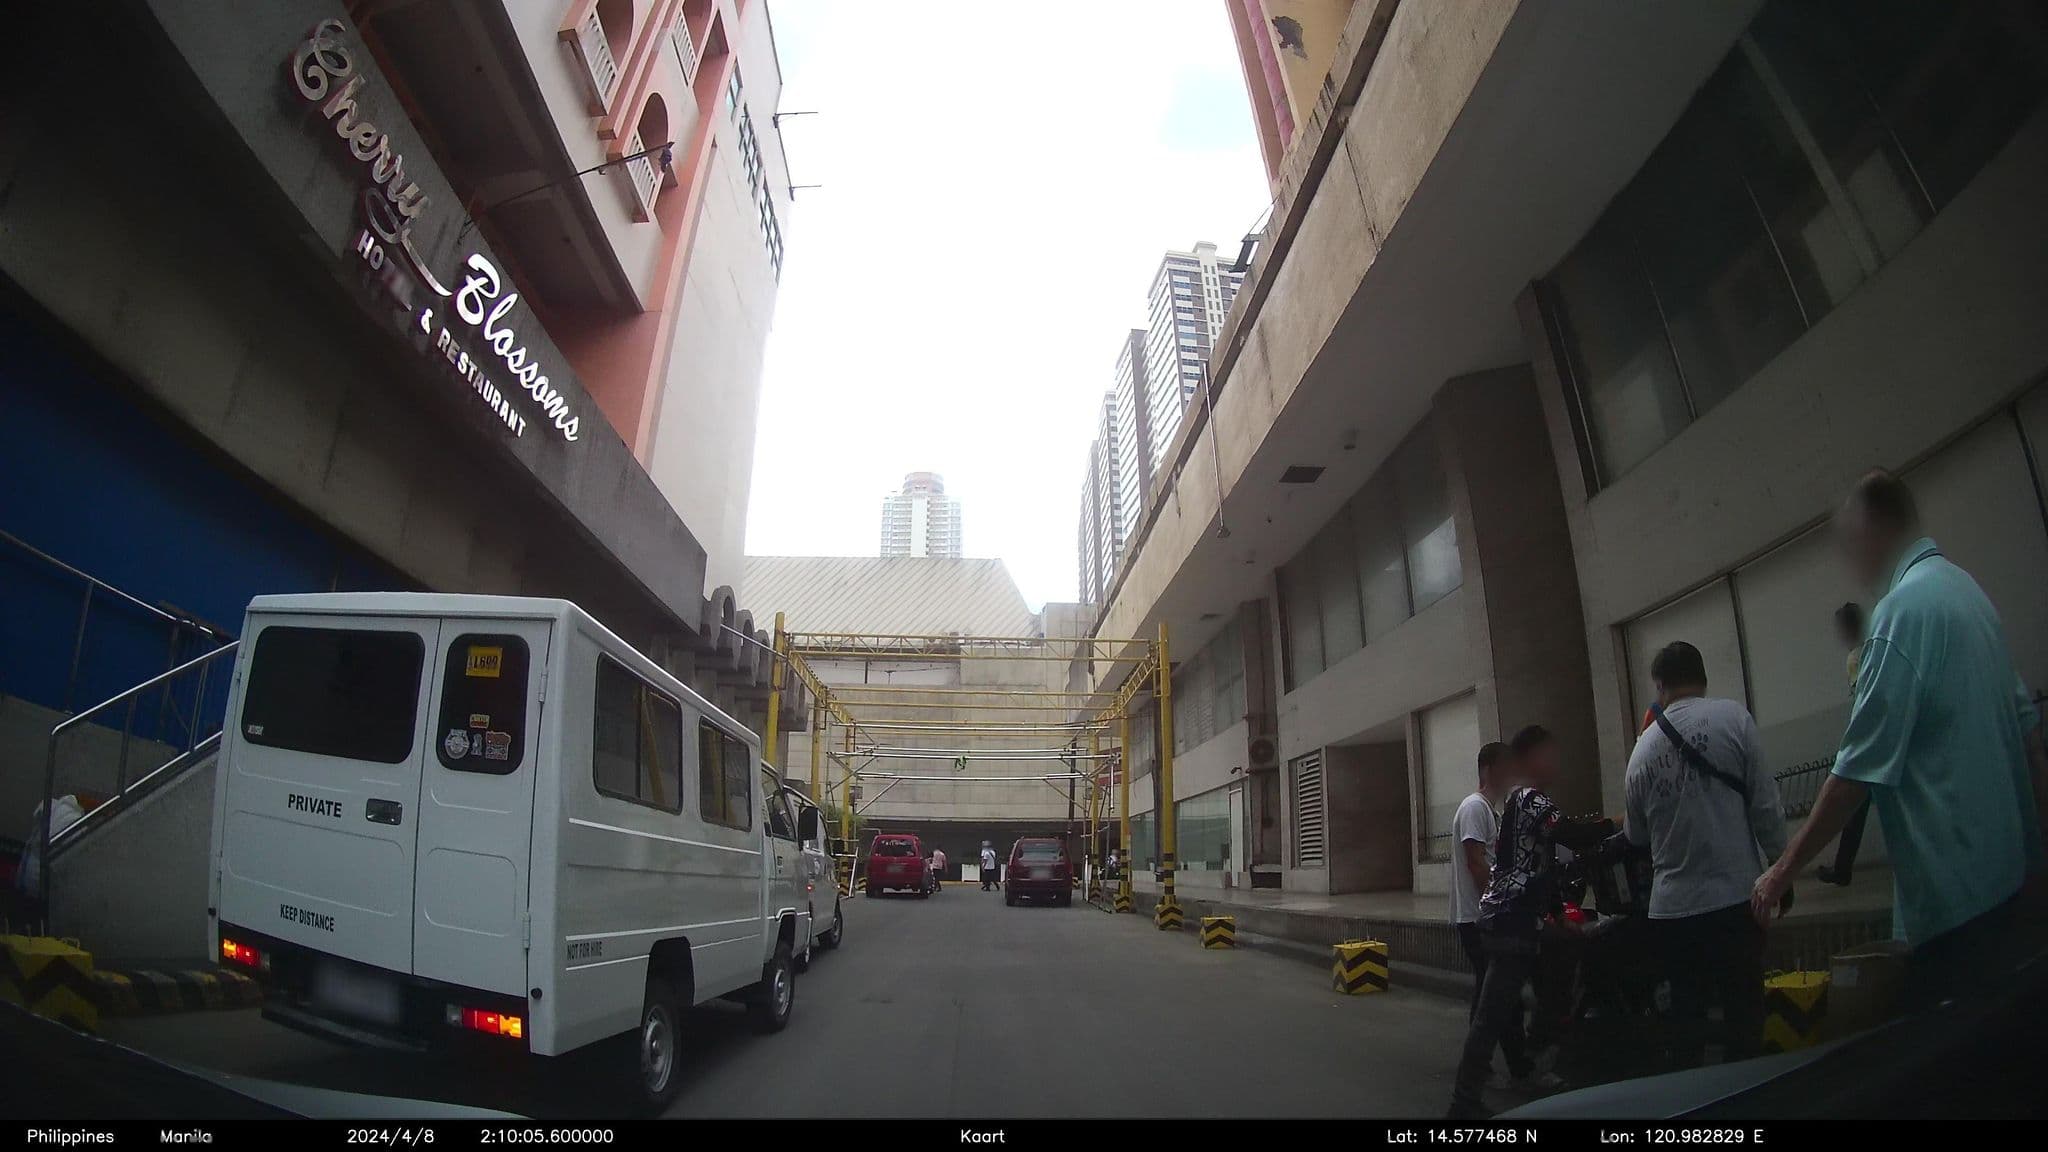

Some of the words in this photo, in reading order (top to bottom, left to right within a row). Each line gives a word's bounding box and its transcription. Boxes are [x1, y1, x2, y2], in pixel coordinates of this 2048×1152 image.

[293, 17, 452, 297] Cherry
[436, 326, 527, 438] RESTAURANT
[456, 253, 580, 442] Blossoms
[287, 793, 343, 819] PRIVATE
[280, 903, 299, 923] KEEP
[299, 908, 335, 933] DISTANCE
[567, 942, 579, 960] NOT
[579, 941, 590, 959] FOR
